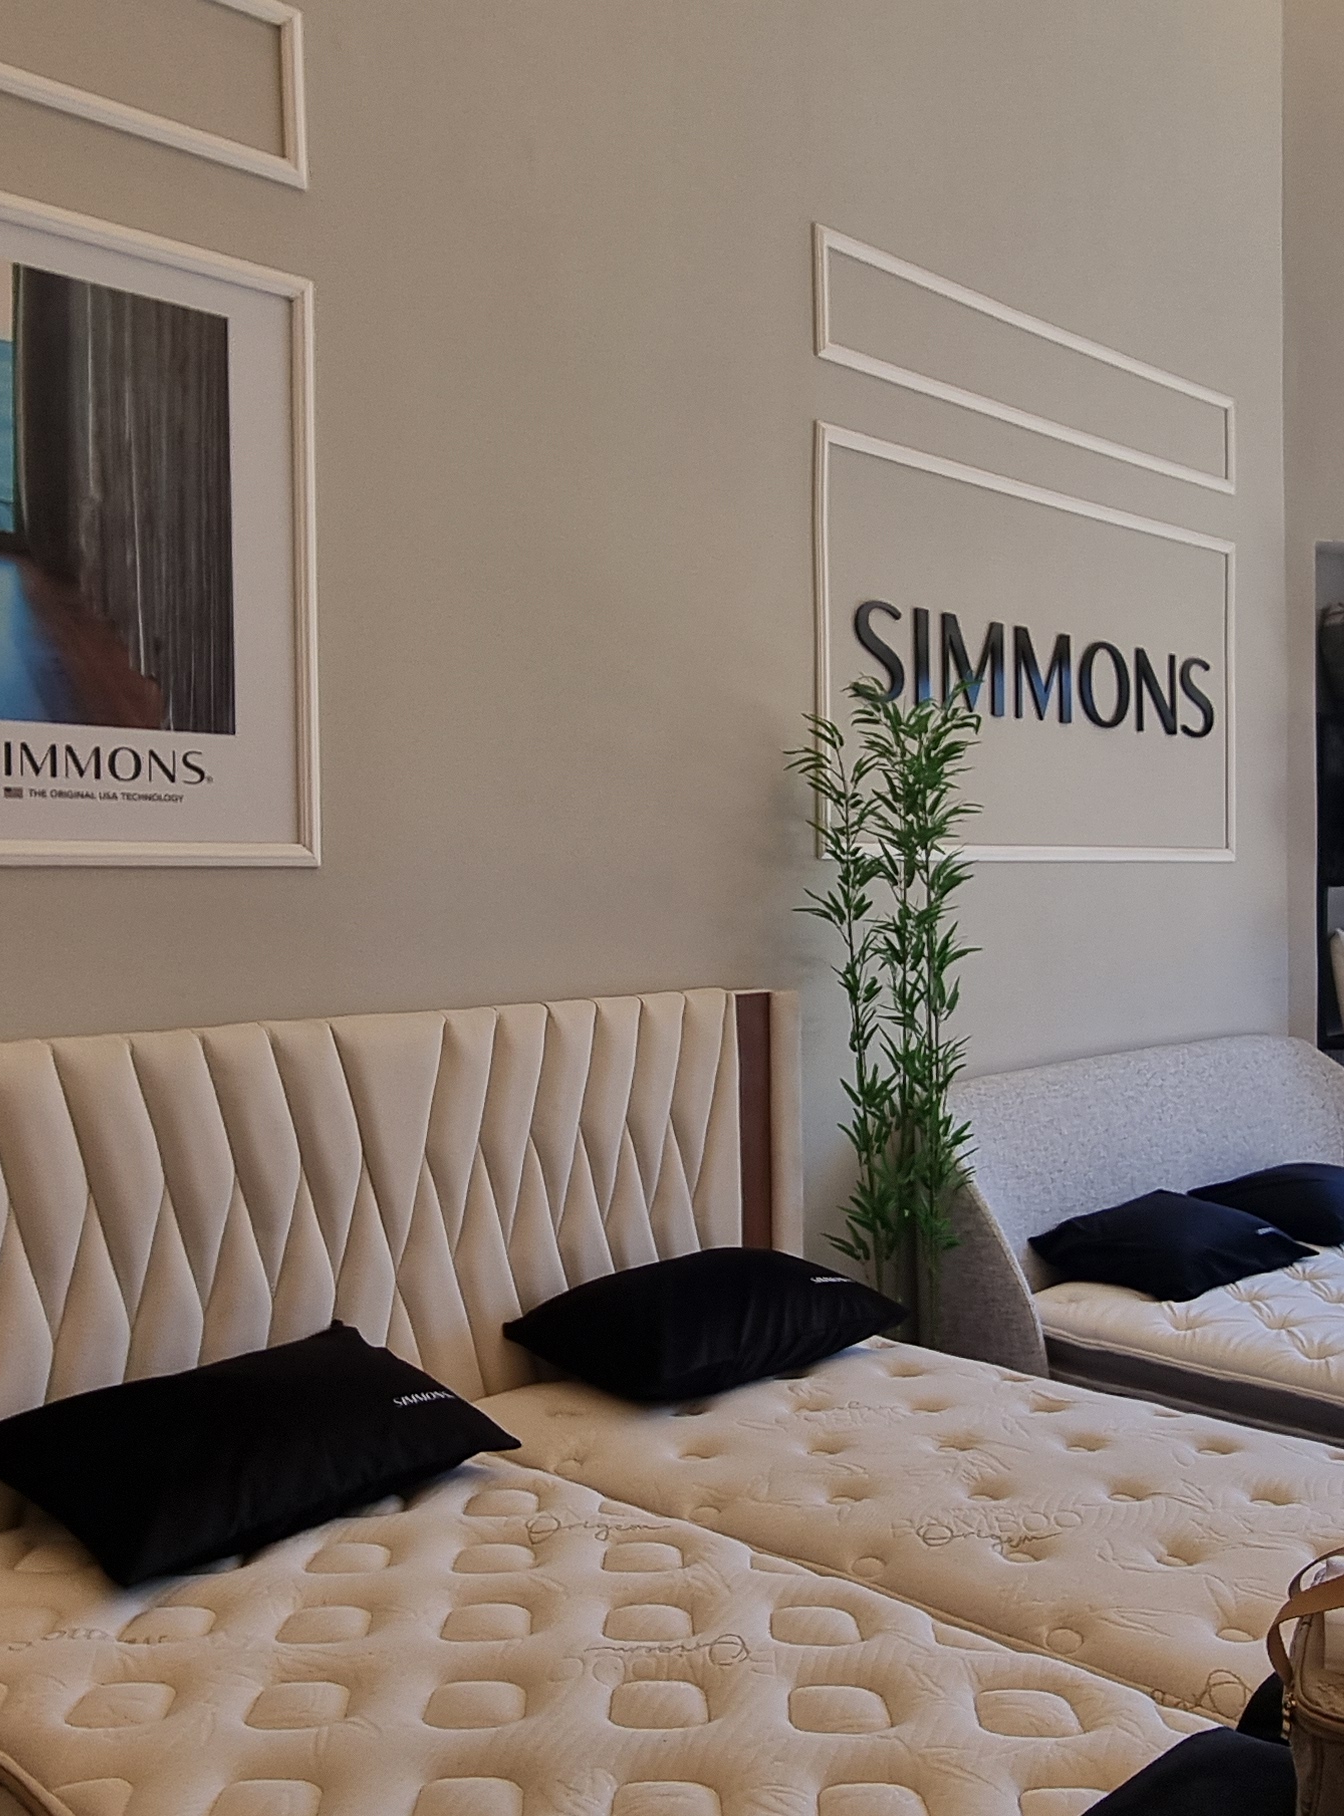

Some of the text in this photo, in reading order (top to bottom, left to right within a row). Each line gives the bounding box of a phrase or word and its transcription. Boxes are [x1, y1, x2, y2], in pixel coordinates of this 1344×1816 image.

[855, 600, 1215, 738] SIMMONS
[28, 788, 184, 803] THE ORIGINAL USA TECHNOLOGY
